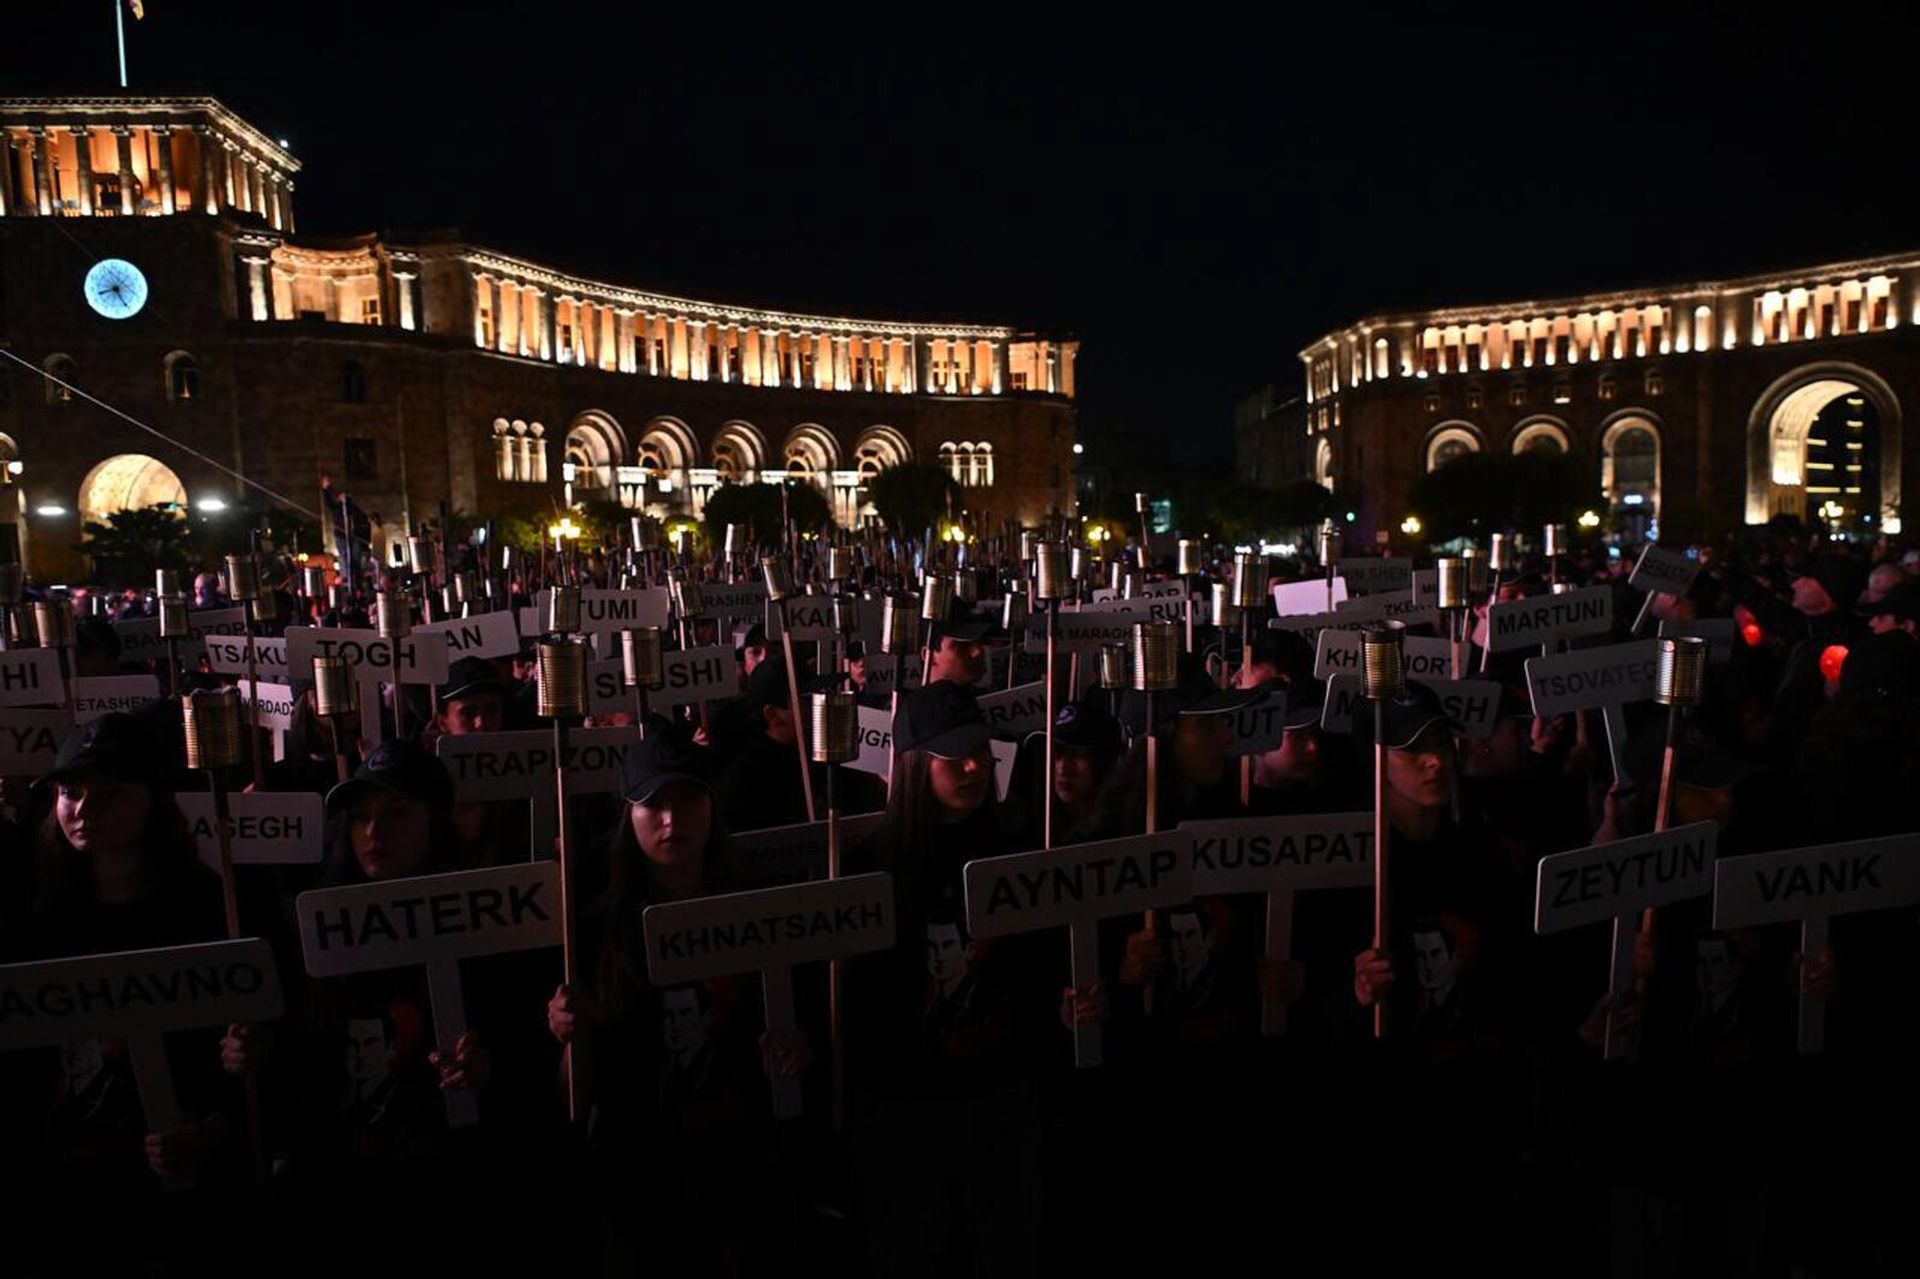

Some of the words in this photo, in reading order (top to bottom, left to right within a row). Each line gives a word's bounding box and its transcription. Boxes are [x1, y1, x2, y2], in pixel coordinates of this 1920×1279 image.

[578, 600, 637, 619] UMI
[1497, 598, 1604, 634] MARTUNI
[316, 641, 413, 668] TOGH
[596, 657, 722, 698] SSHI
[0, 727, 57, 753] YA
[1229, 706, 1280, 738] UT
[1192, 832, 1374, 869] KUSAPAT
[986, 850, 1178, 916] AYNTAP
[1552, 840, 1705, 908] ZEYTUN
[1755, 855, 1882, 902] VANK
[315, 881, 550, 951] HATERK
[658, 902, 882, 961] KHNATSAKH
[0, 962, 263, 1023] AGHAVNO
